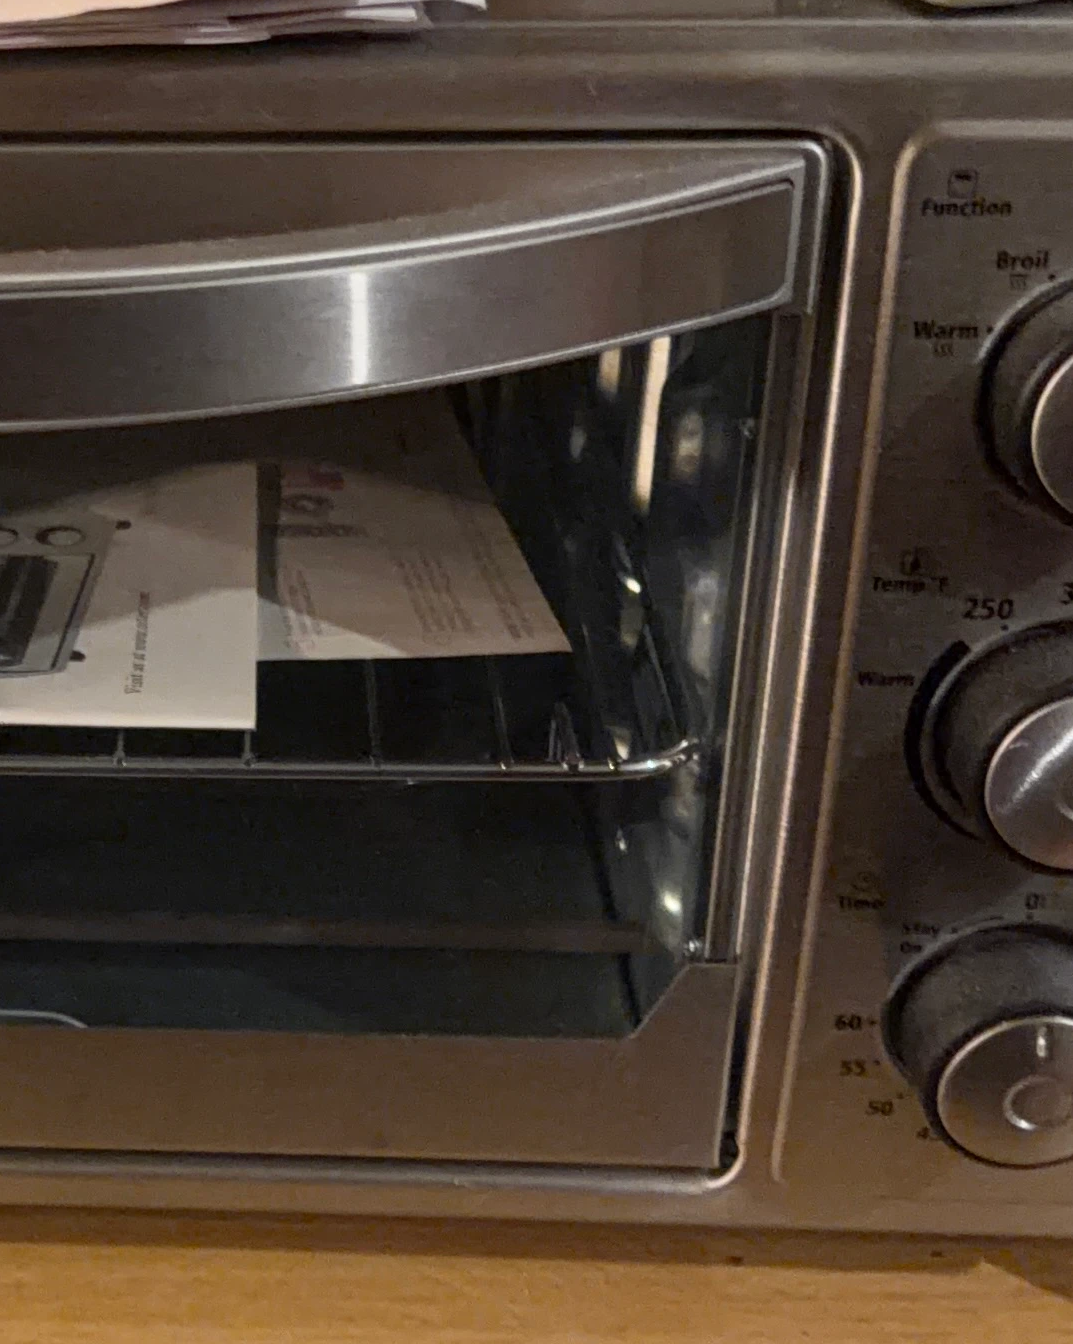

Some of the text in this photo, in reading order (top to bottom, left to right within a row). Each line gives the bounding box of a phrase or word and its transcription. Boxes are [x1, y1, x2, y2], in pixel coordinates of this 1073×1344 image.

[920, 197, 1013, 218] Function
[996, 251, 1050, 271] Broil
[913, 321, 979, 340] Warm
[872, 577, 926, 593] Temp
[961, 597, 1015, 619] 250
[834, 1014, 863, 1031] 60
[866, 1099, 894, 1117] 50
